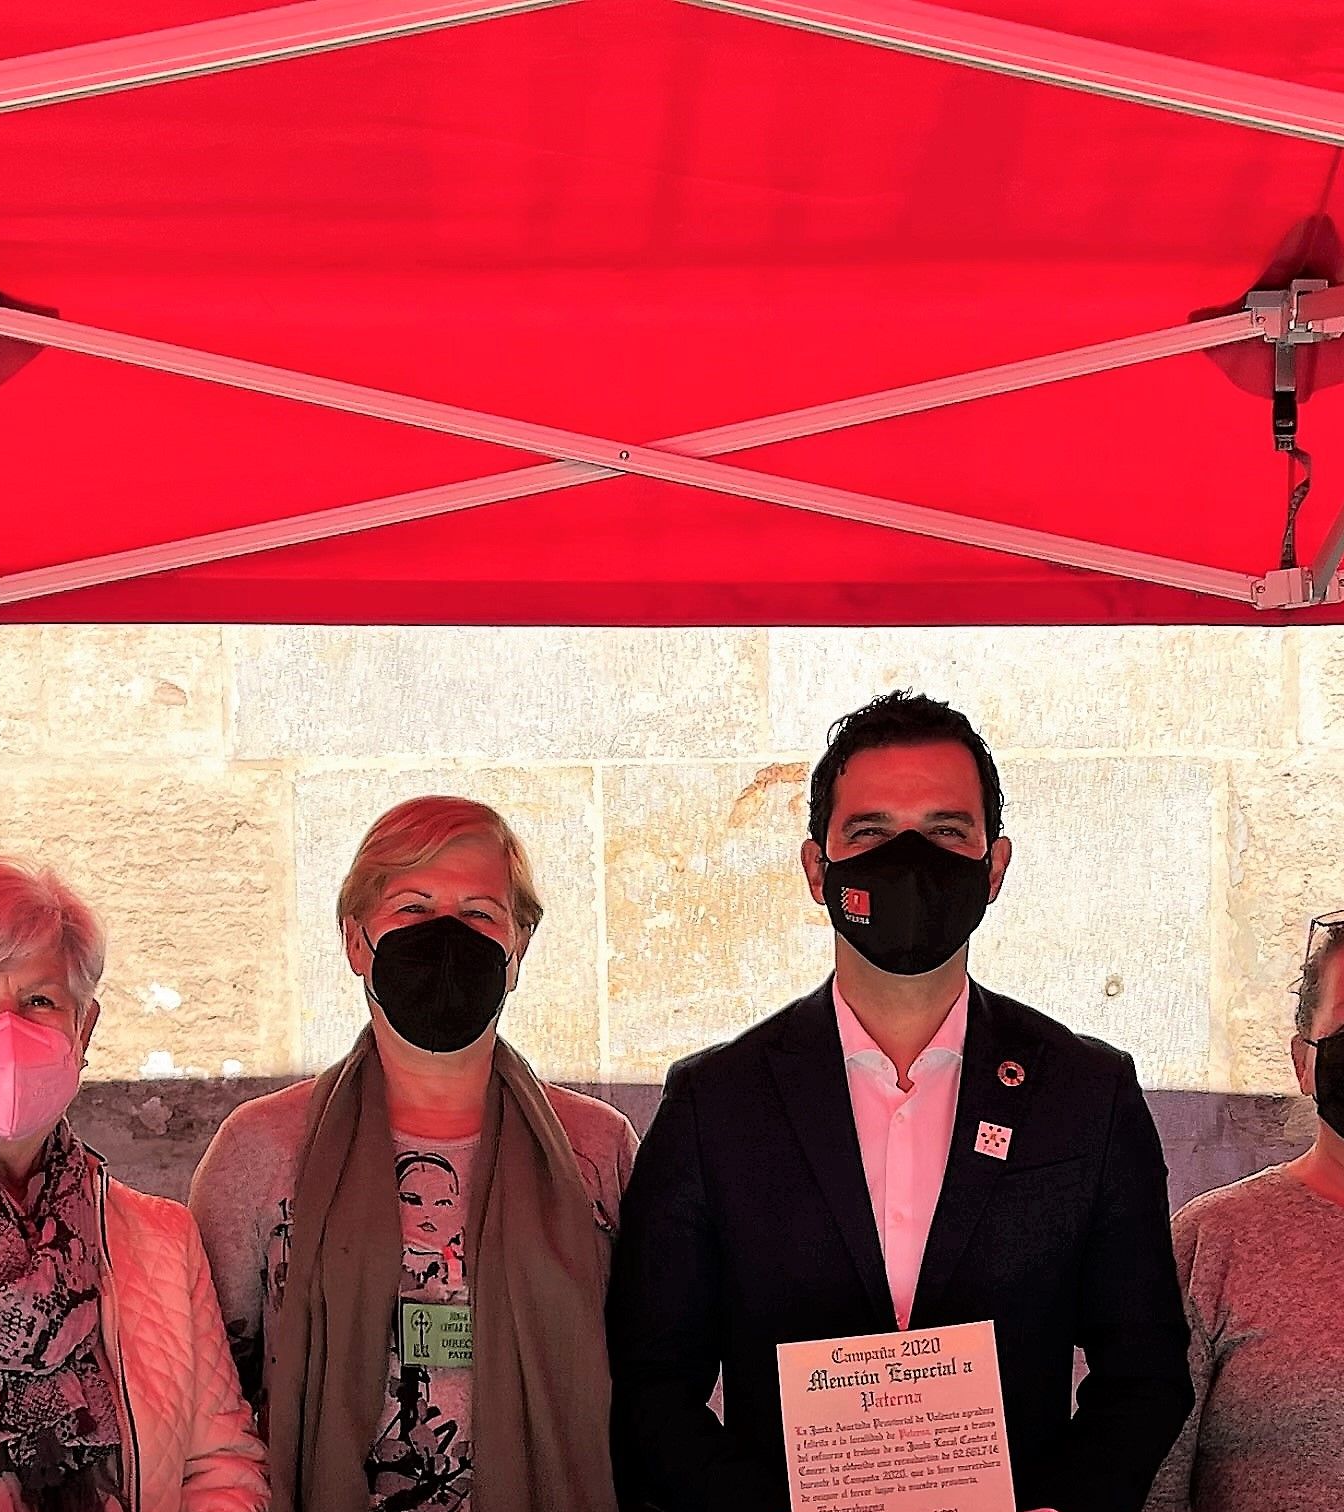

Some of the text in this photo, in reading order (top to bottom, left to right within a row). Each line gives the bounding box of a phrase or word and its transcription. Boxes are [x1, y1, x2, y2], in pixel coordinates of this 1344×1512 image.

[831, 1337, 941, 1365] Campaña 2020
[806, 1356, 973, 1392] Mención Especial a
[861, 1391, 922, 1412] Paterna
